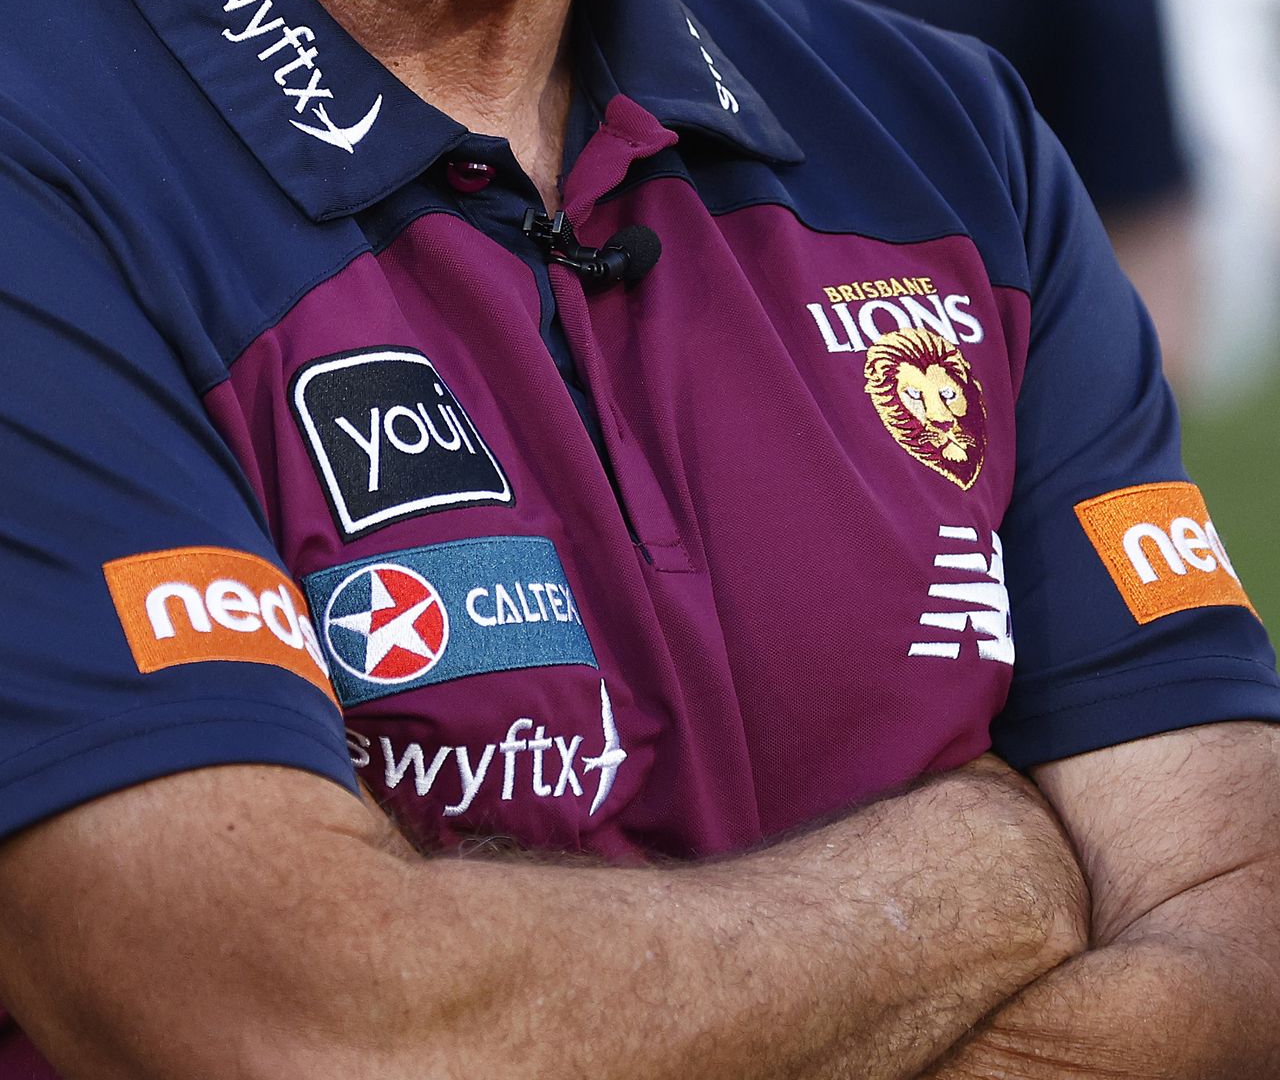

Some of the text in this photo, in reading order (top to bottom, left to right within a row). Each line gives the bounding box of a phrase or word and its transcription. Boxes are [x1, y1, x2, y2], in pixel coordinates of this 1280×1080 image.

[823, 277, 938, 303] BRISBANE
[806, 294, 985, 353] LIONS
[334, 382, 477, 493] youi
[465, 581, 582, 627] CALTEX
